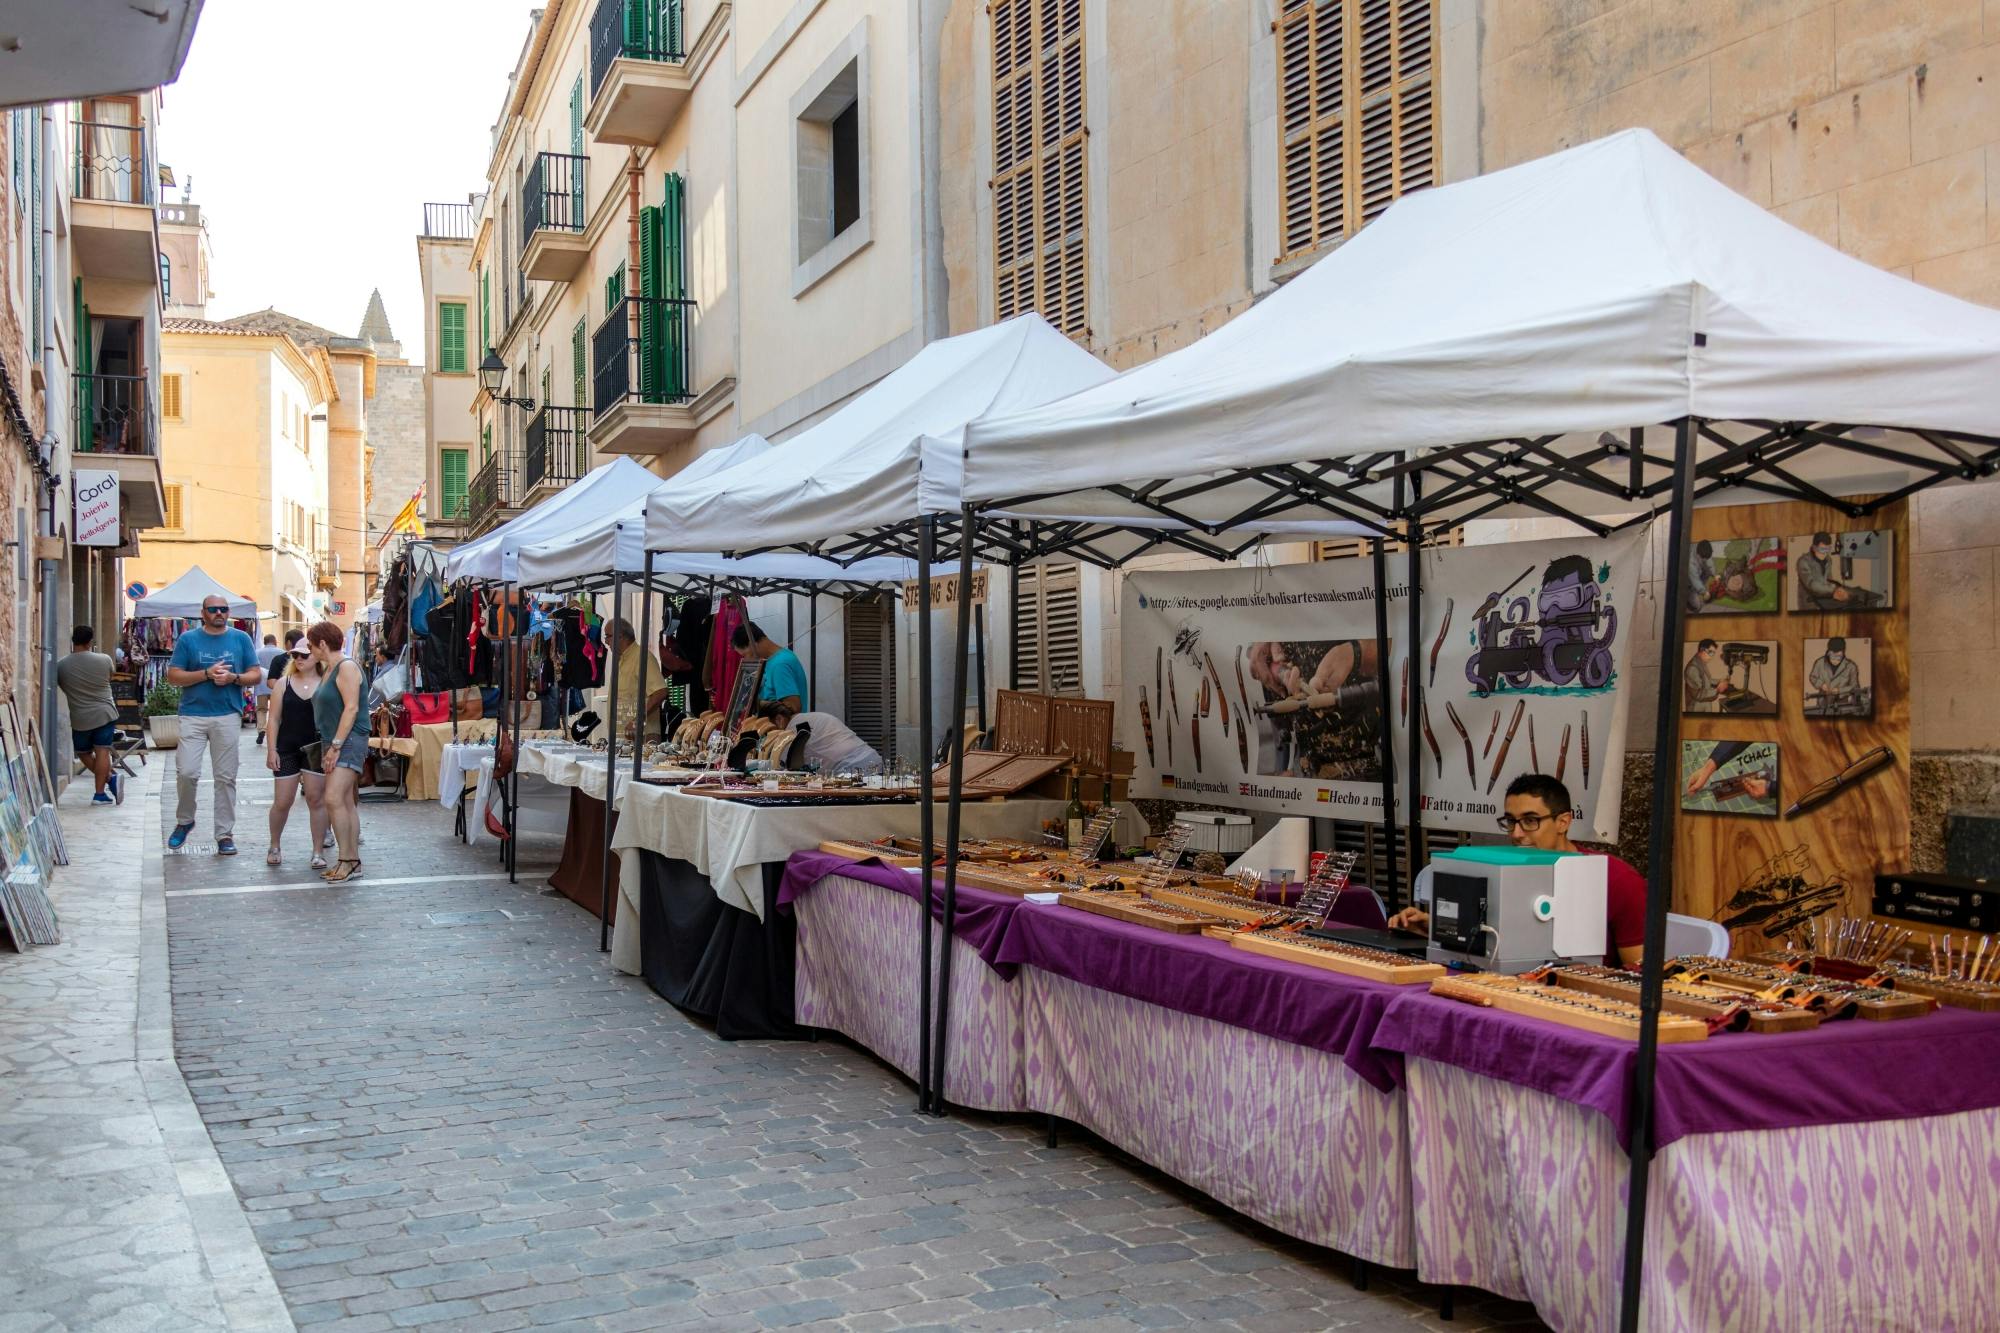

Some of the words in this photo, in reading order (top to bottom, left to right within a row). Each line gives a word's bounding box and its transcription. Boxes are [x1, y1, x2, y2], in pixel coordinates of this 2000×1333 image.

[79, 474, 117, 502] Coral
[79, 516, 117, 541] Rellotgeria
[904, 582, 941, 607] STENG
[946, 575, 985, 603] SIER
[1149, 583, 1425, 612] http://sites.google.com/site/bolisartesanalesmalloquins
[1736, 746, 1772, 766] TCHAC!
[1175, 778, 1229, 794] Handgemacht
[1250, 784, 1302, 801] Handmade
[1329, 790, 1360, 806] Hecho
[1362, 796, 1369, 806] a
[1371, 796, 1400, 807] mo
[1426, 796, 1454, 812] Fatto
[1456, 802, 1463, 812] a
[1466, 802, 1497, 815] mano
